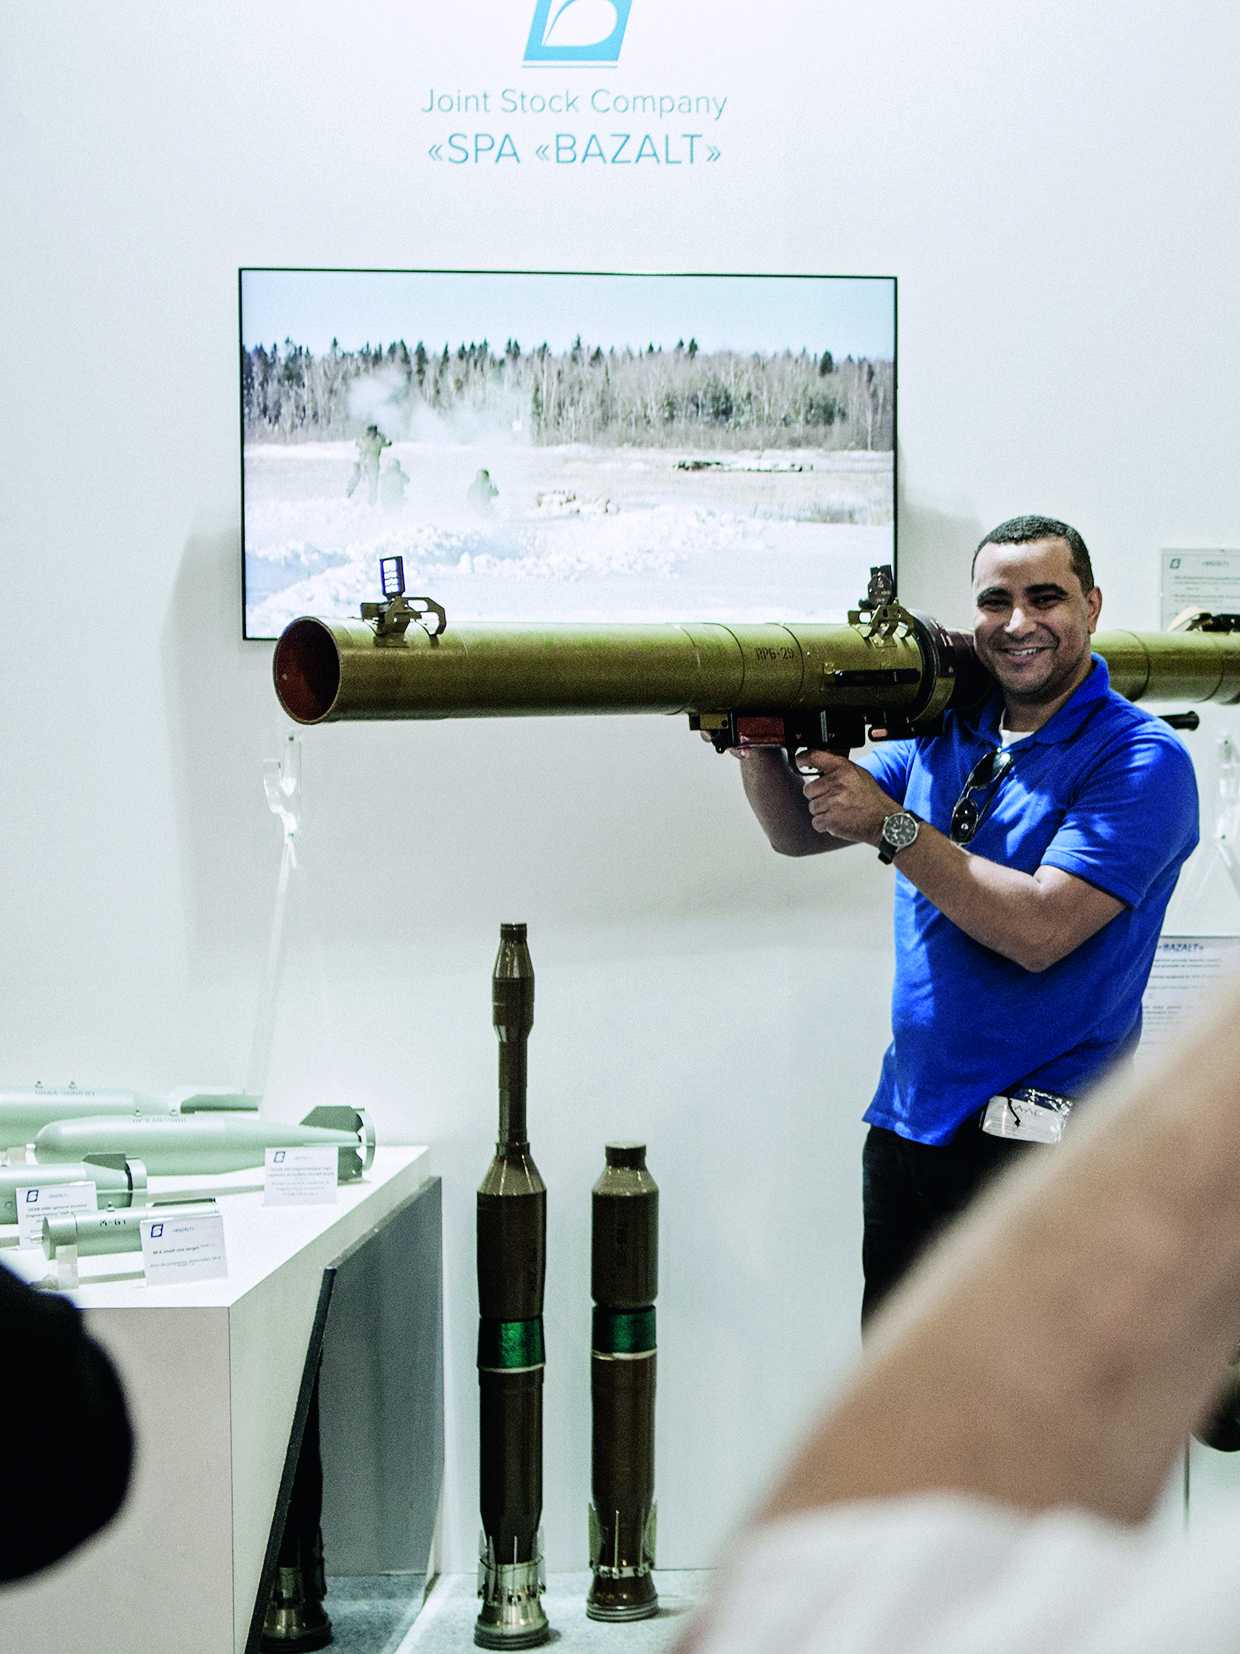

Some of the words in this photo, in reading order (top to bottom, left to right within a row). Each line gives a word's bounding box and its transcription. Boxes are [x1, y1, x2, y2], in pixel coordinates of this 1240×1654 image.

[421, 88, 490, 114] Joint
[501, 88, 581, 114] Stock
[591, 88, 728, 120] Company
[428, 133, 521, 164] «SPA
[535, 133, 722, 164] «BAZALT»
